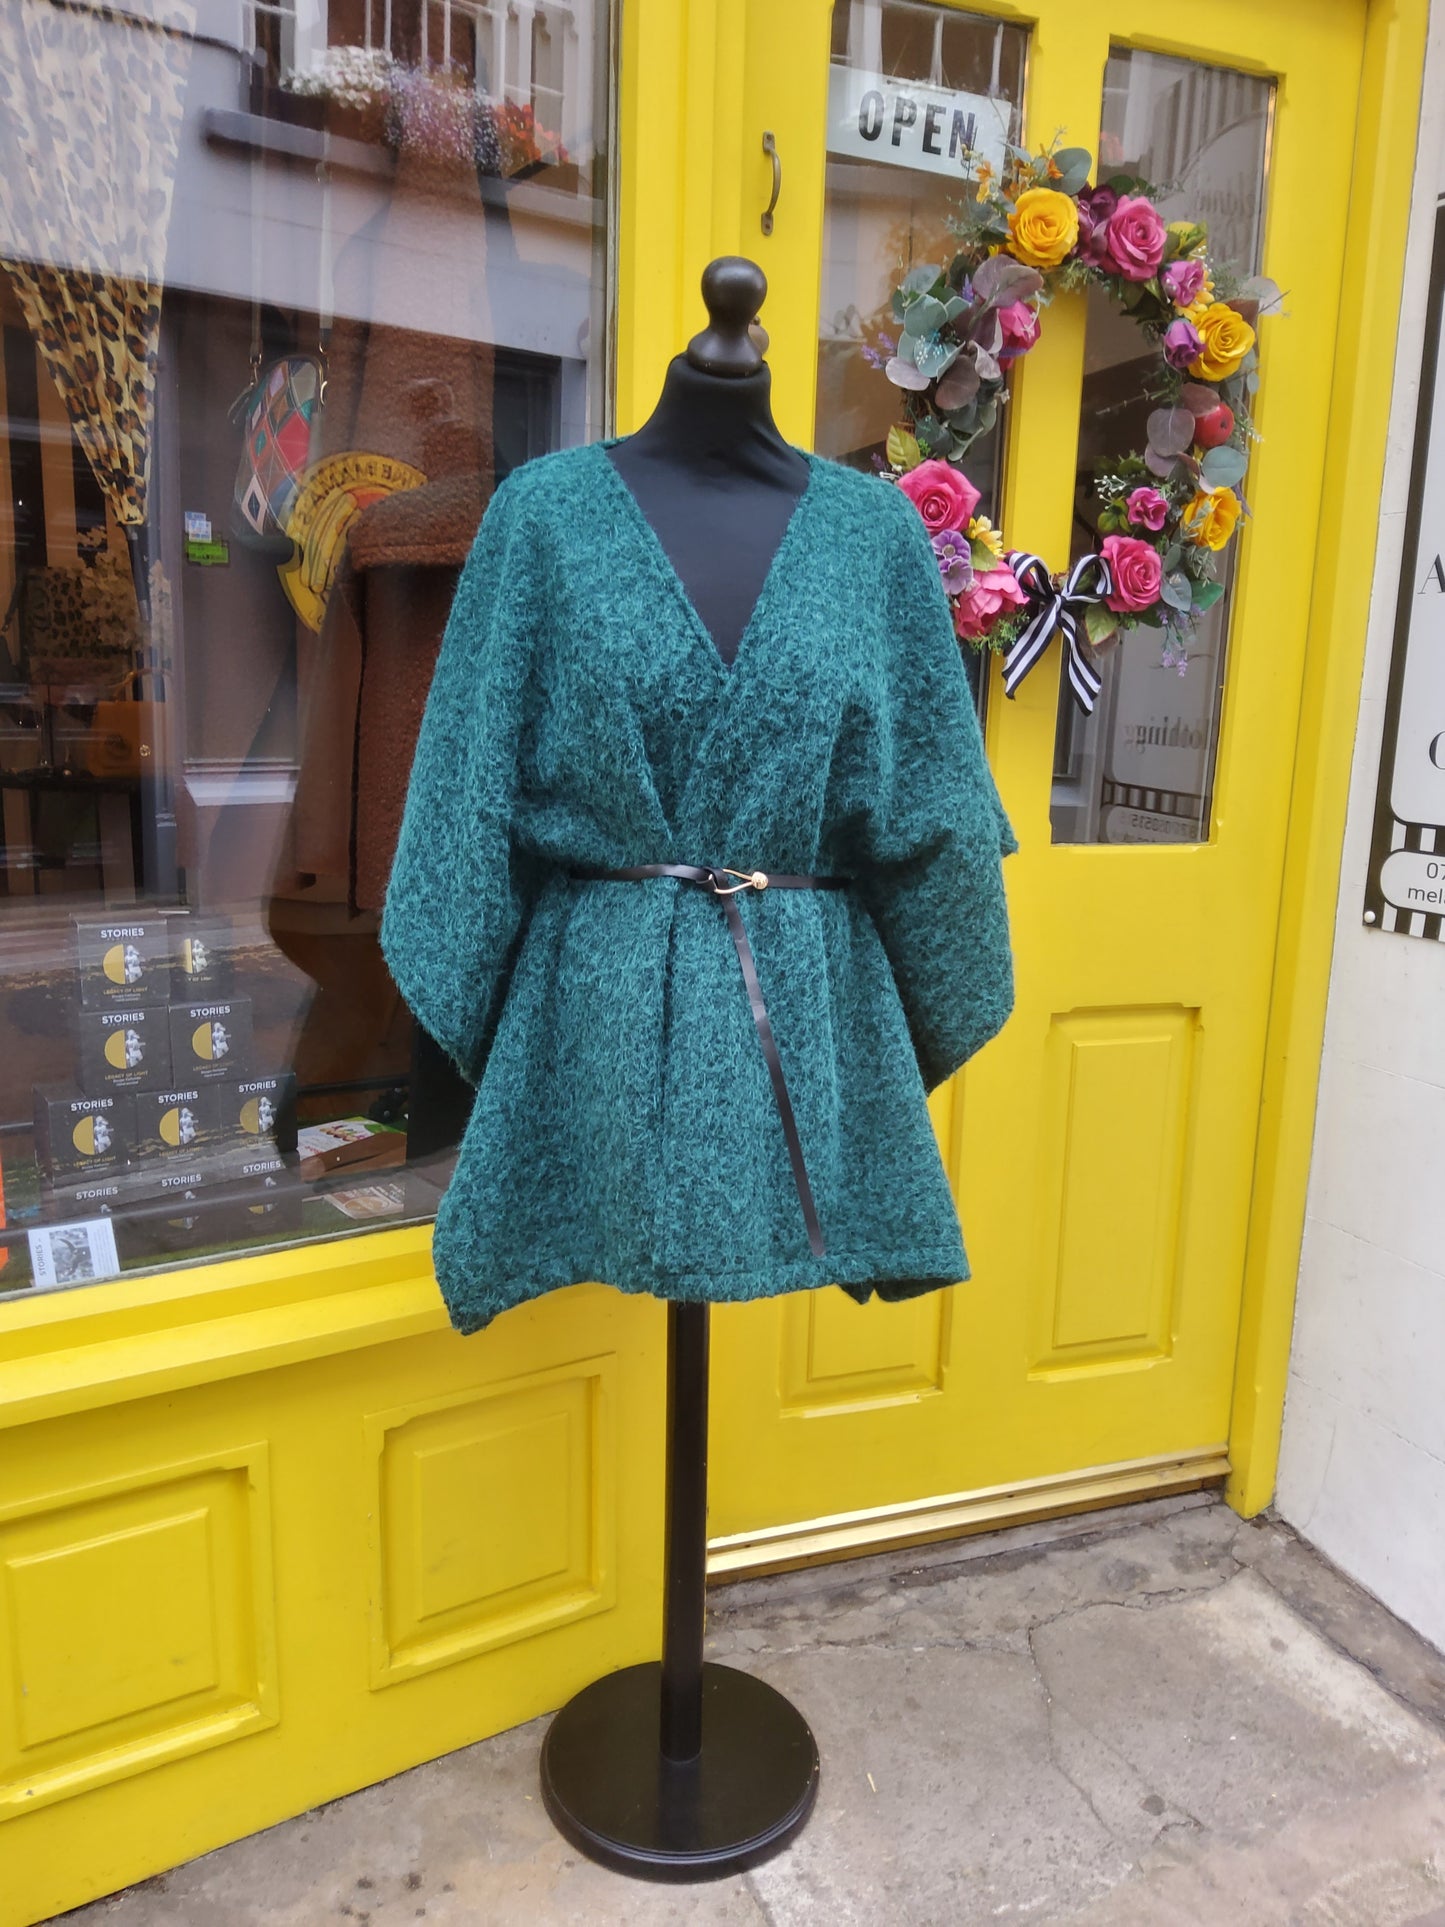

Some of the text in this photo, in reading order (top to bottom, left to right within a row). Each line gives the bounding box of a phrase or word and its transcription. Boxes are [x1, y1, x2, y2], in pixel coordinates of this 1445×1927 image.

[857, 90, 976, 159] OPEN
[1408, 887, 1445, 904] mel
[100, 927, 145, 939] STORIES
[101, 1012, 145, 1024] STORIES
[190, 1005, 231, 1018] STORIES
[238, 1079, 277, 1093] STORIES
[158, 1090, 199, 1104] STORIES
[70, 1098, 114, 1112] STORIES
[242, 1160, 282, 1174] STORIES
[161, 1173, 202, 1187] STORIES
[75, 1186, 119, 1200] STORIES
[35, 1244, 47, 1276] STORIES
